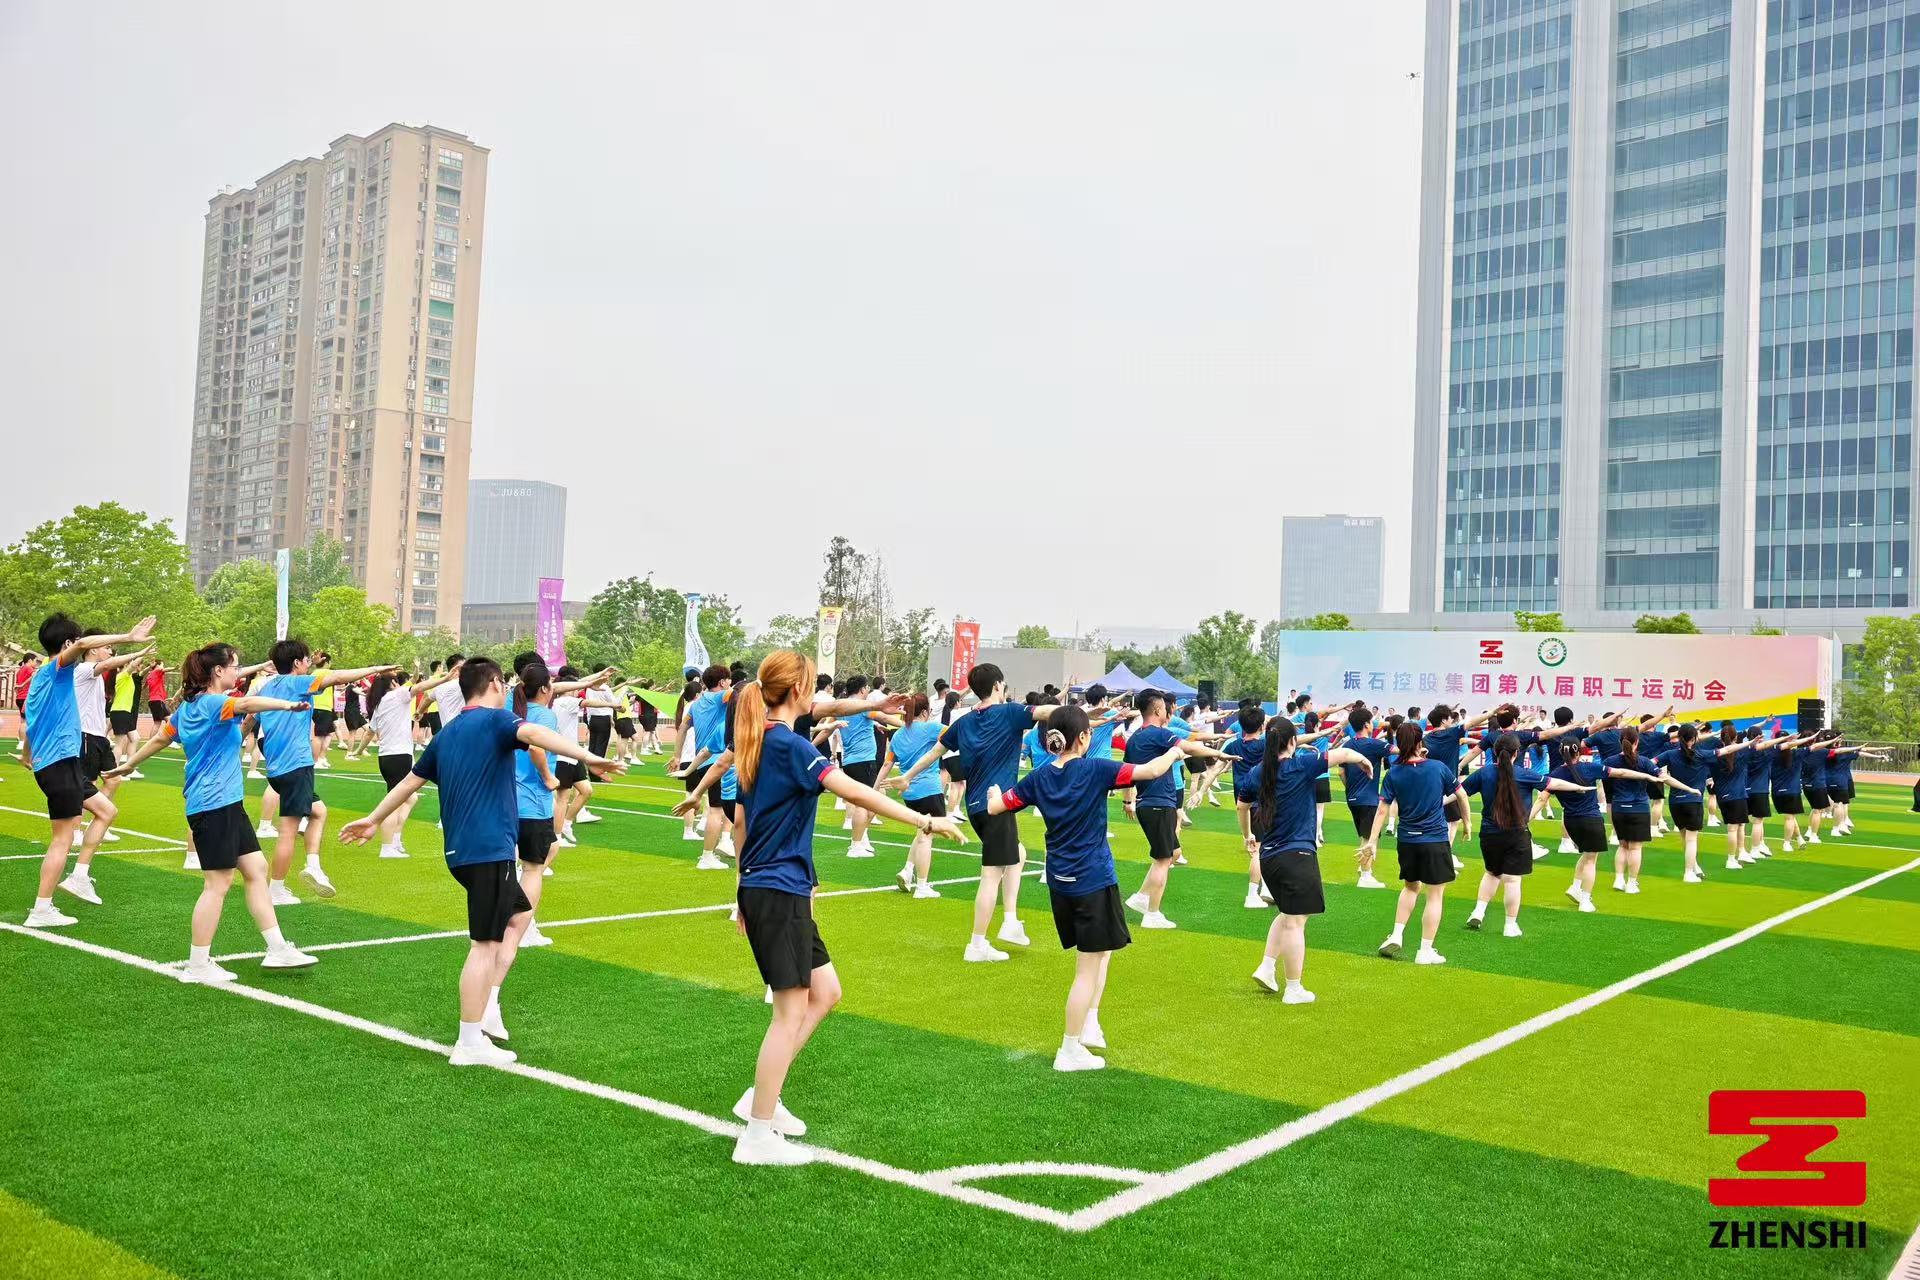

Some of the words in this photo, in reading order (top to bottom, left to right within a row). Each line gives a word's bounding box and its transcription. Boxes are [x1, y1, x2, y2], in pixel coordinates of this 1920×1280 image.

[1343, 671, 1727, 702] 振石控股集团第八届职工运动会
